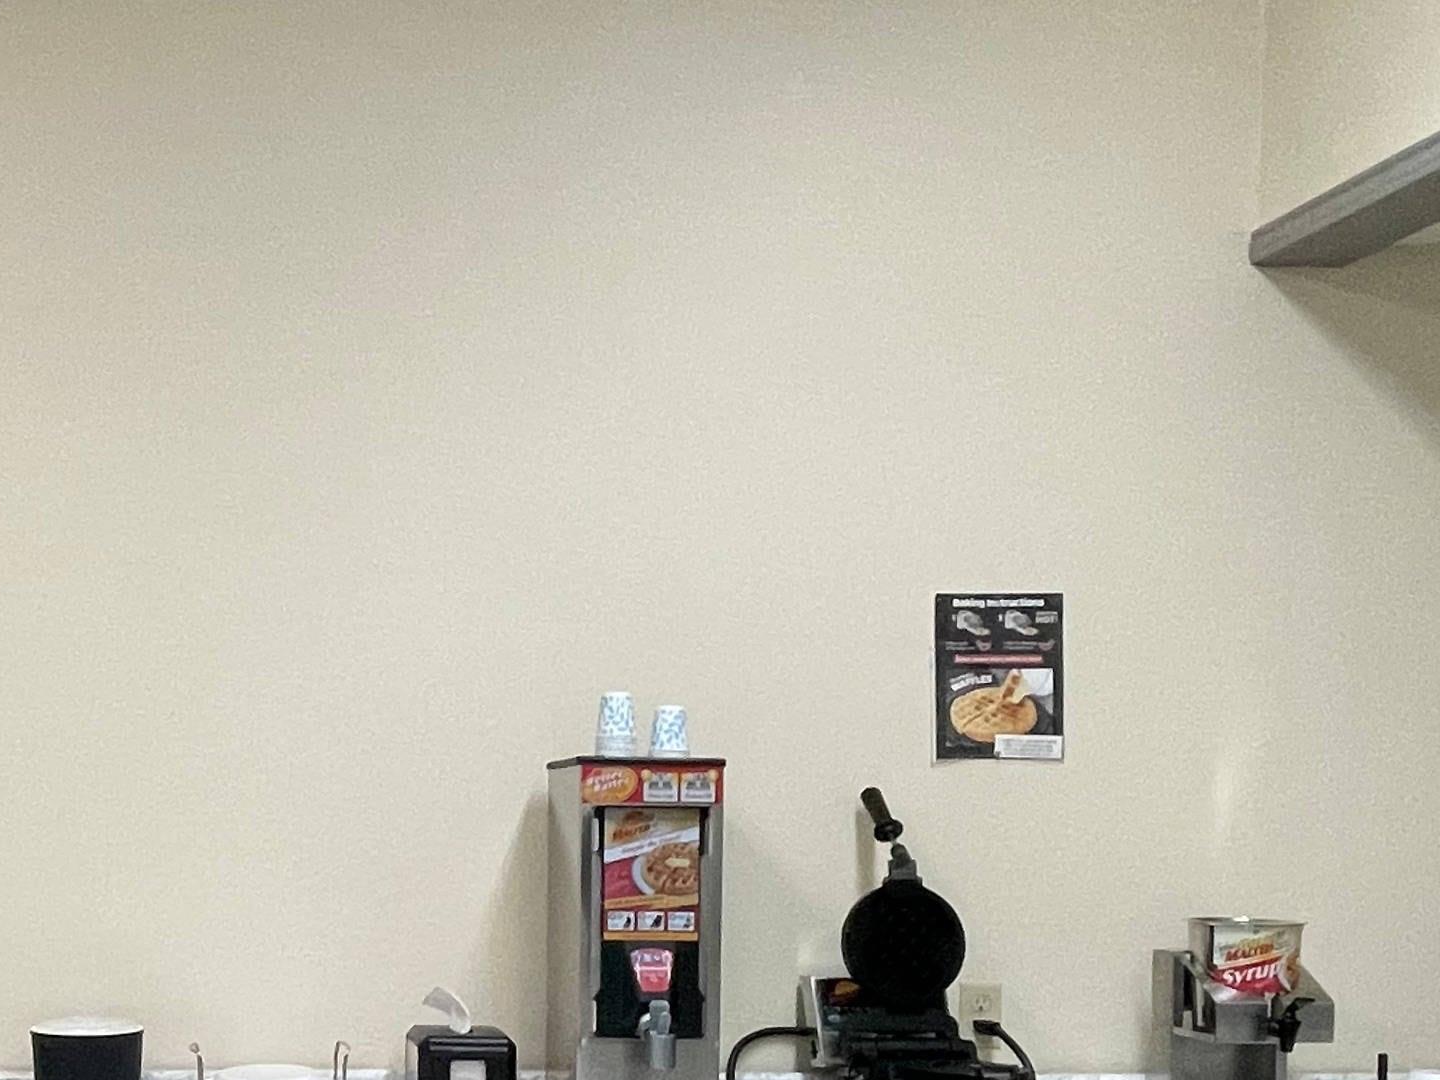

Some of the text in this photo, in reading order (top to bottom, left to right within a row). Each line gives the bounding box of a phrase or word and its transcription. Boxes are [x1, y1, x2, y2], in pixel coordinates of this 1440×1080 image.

[952, 598, 1045, 609] Baking Instructions
[1222, 961, 1284, 986] Syrup
